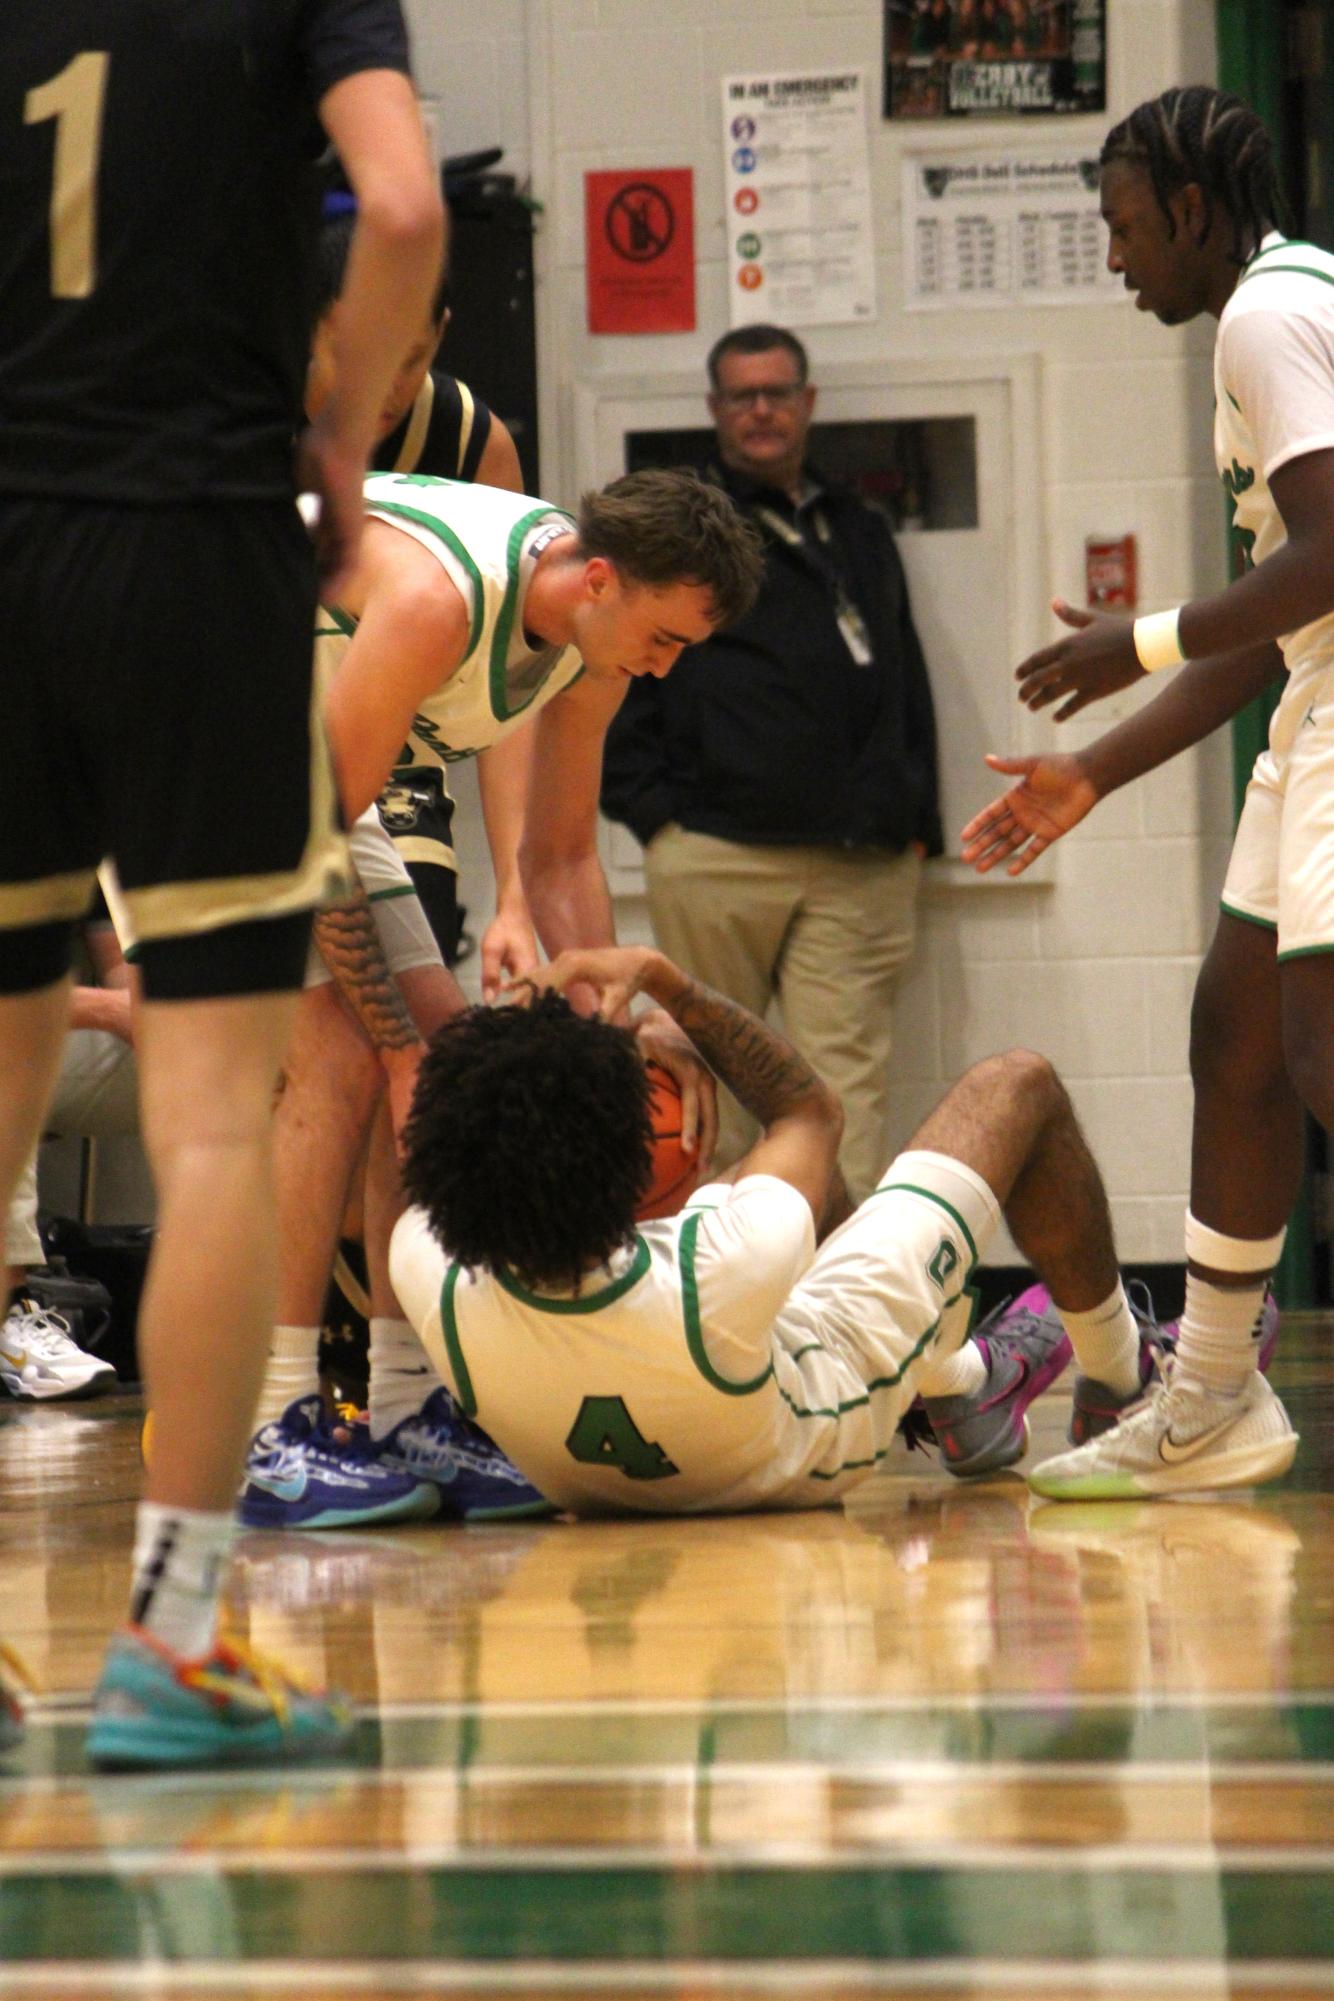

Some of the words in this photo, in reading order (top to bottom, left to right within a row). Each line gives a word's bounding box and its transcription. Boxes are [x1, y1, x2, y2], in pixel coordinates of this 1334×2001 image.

[774, 75, 858, 95] EMERGENCY
[23, 50, 111, 299] 1
[564, 1394, 681, 1481] 4
